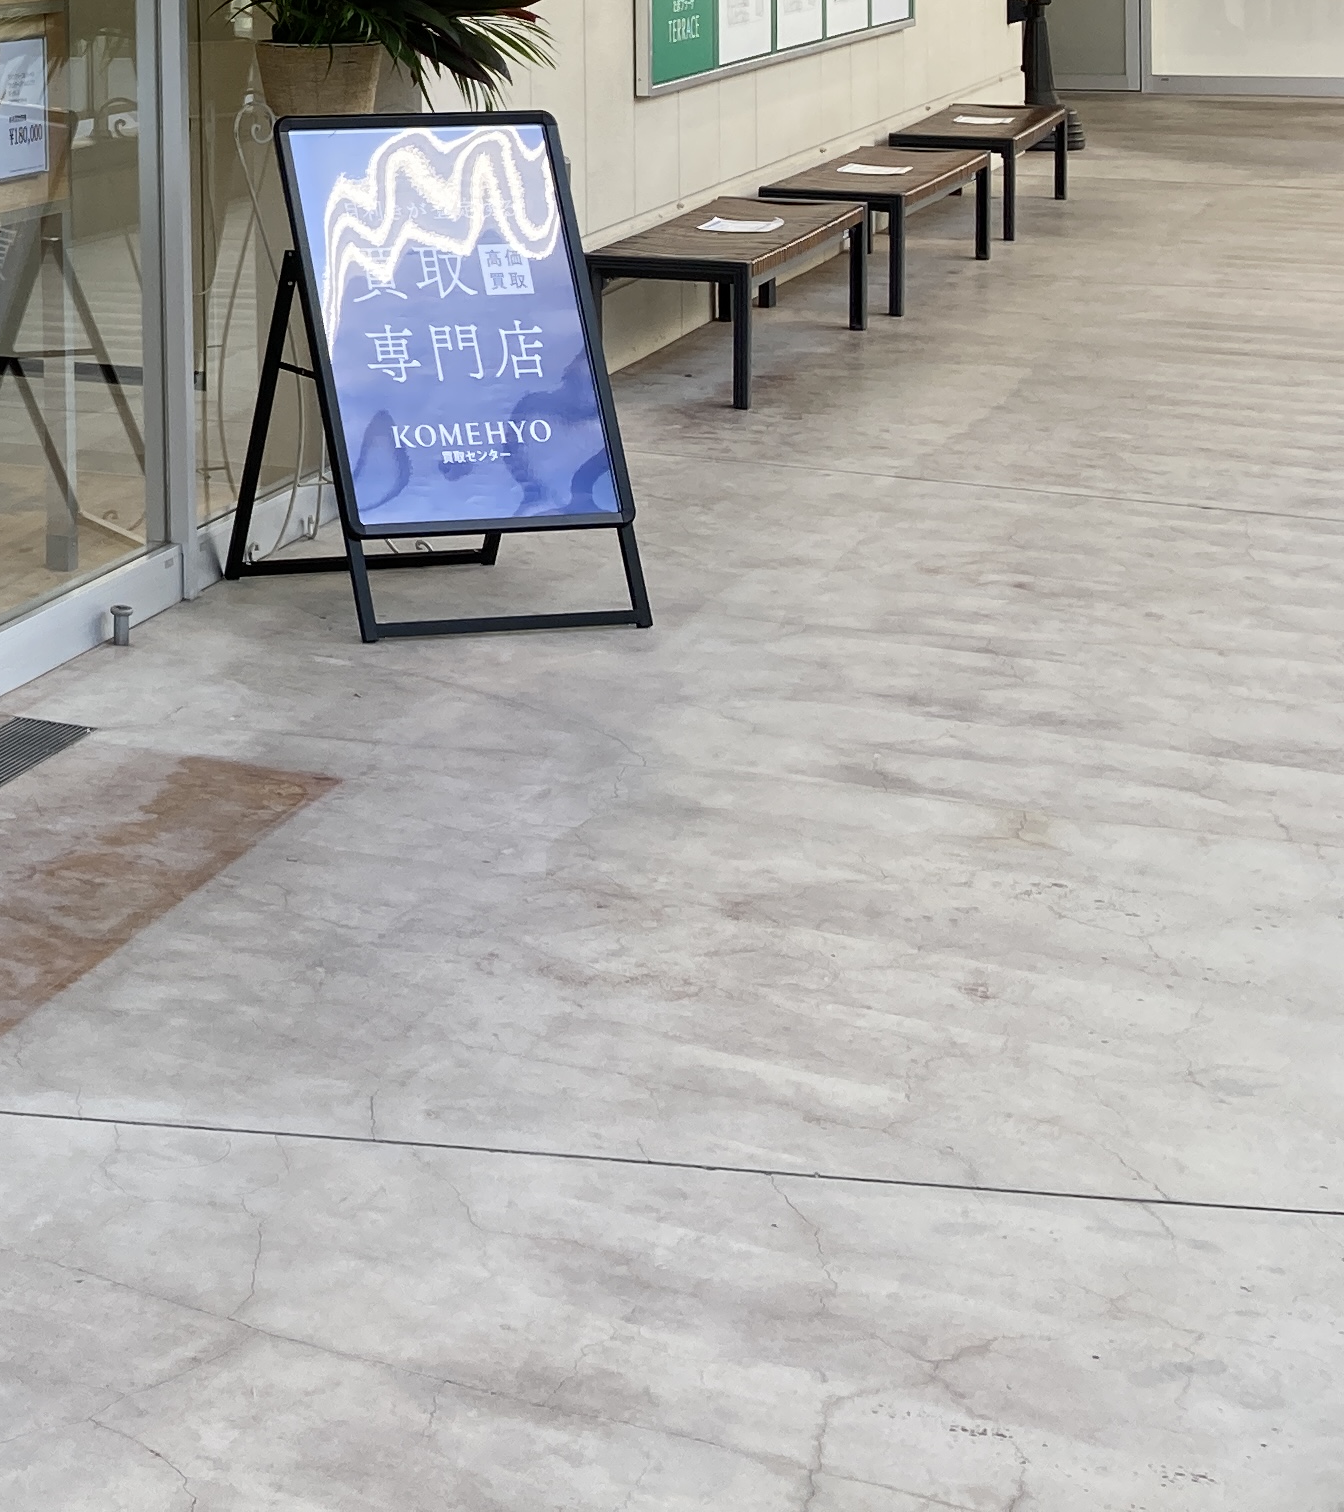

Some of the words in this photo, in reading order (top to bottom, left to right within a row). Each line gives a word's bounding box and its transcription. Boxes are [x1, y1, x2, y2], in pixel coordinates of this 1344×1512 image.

[668, 14, 700, 43] TERRACE
[364, 318, 545, 384] 専門店
[390, 419, 553, 450] KOMEHYO
[441, 449, 512, 465] 買取センター
